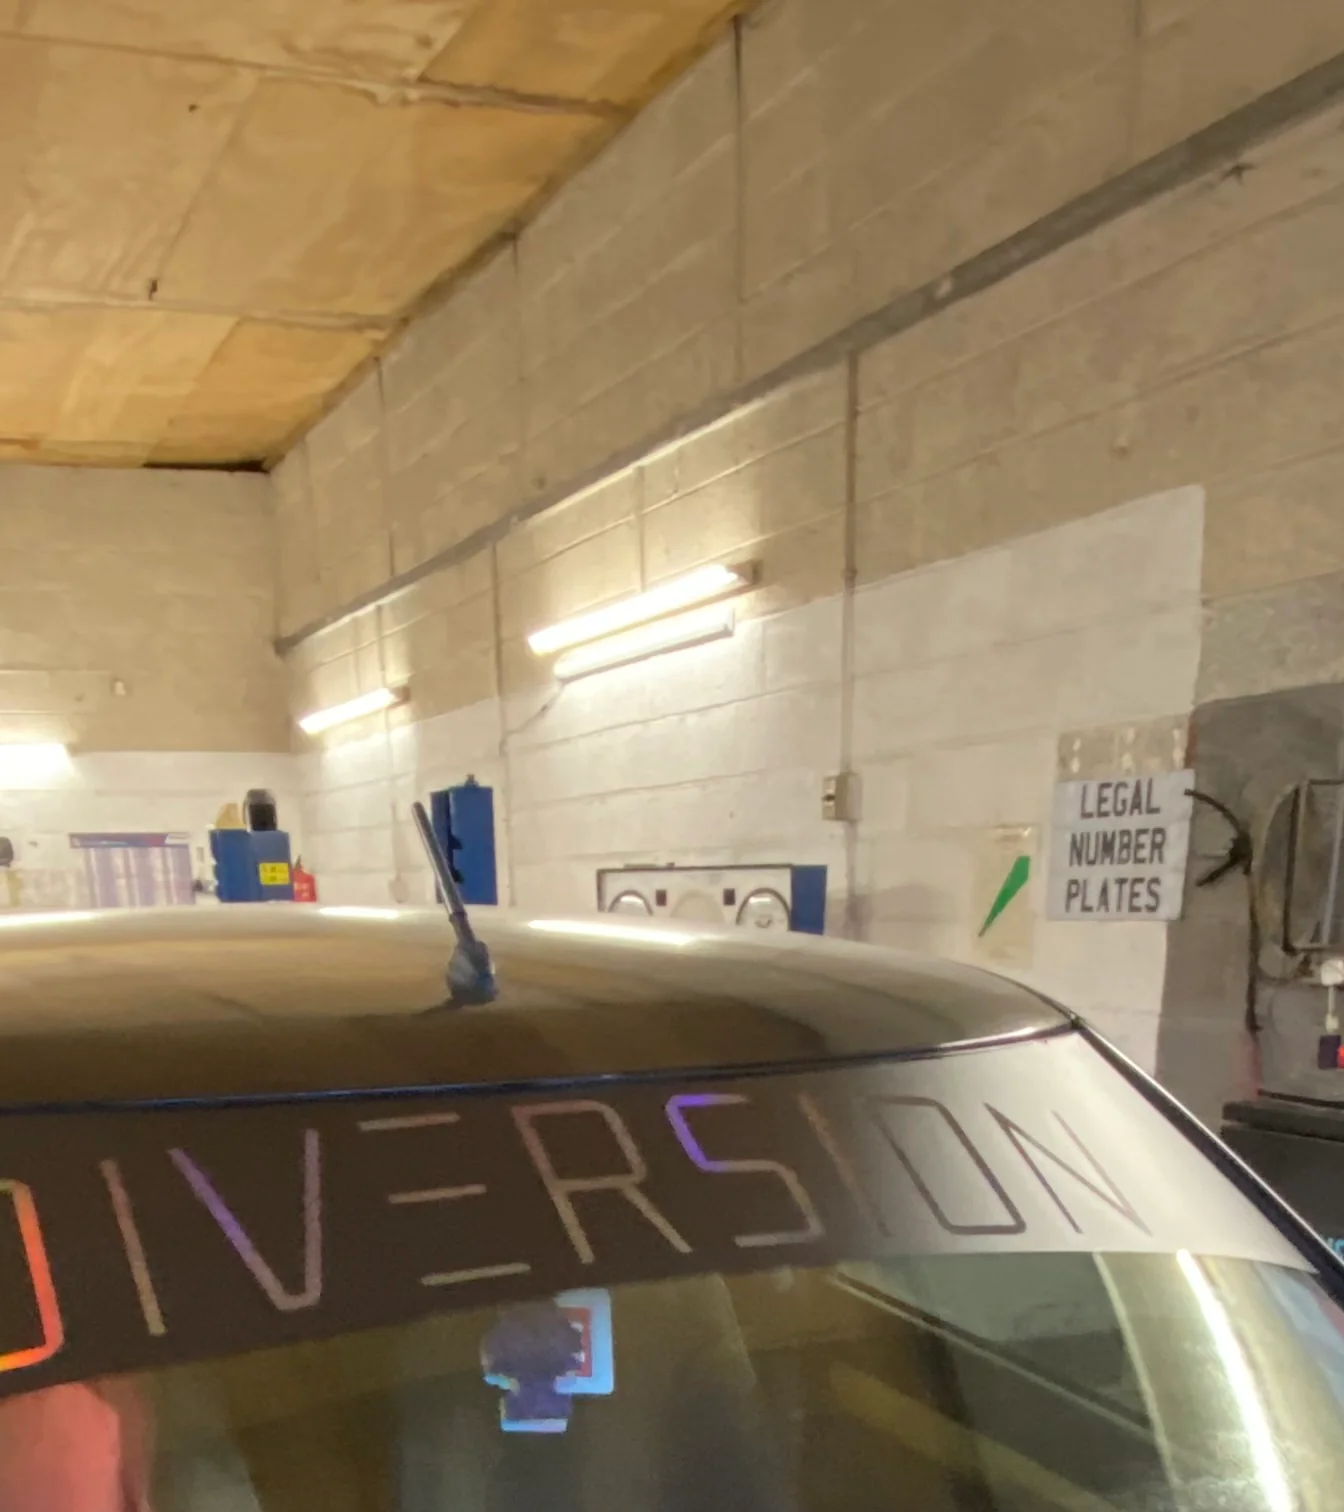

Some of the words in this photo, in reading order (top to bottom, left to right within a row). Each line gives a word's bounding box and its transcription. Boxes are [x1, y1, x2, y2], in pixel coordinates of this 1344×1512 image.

[1080, 778, 1161, 820] LEGAL
[1069, 827, 1166, 868] NUMBER
[1065, 877, 1161, 913] PLATES
